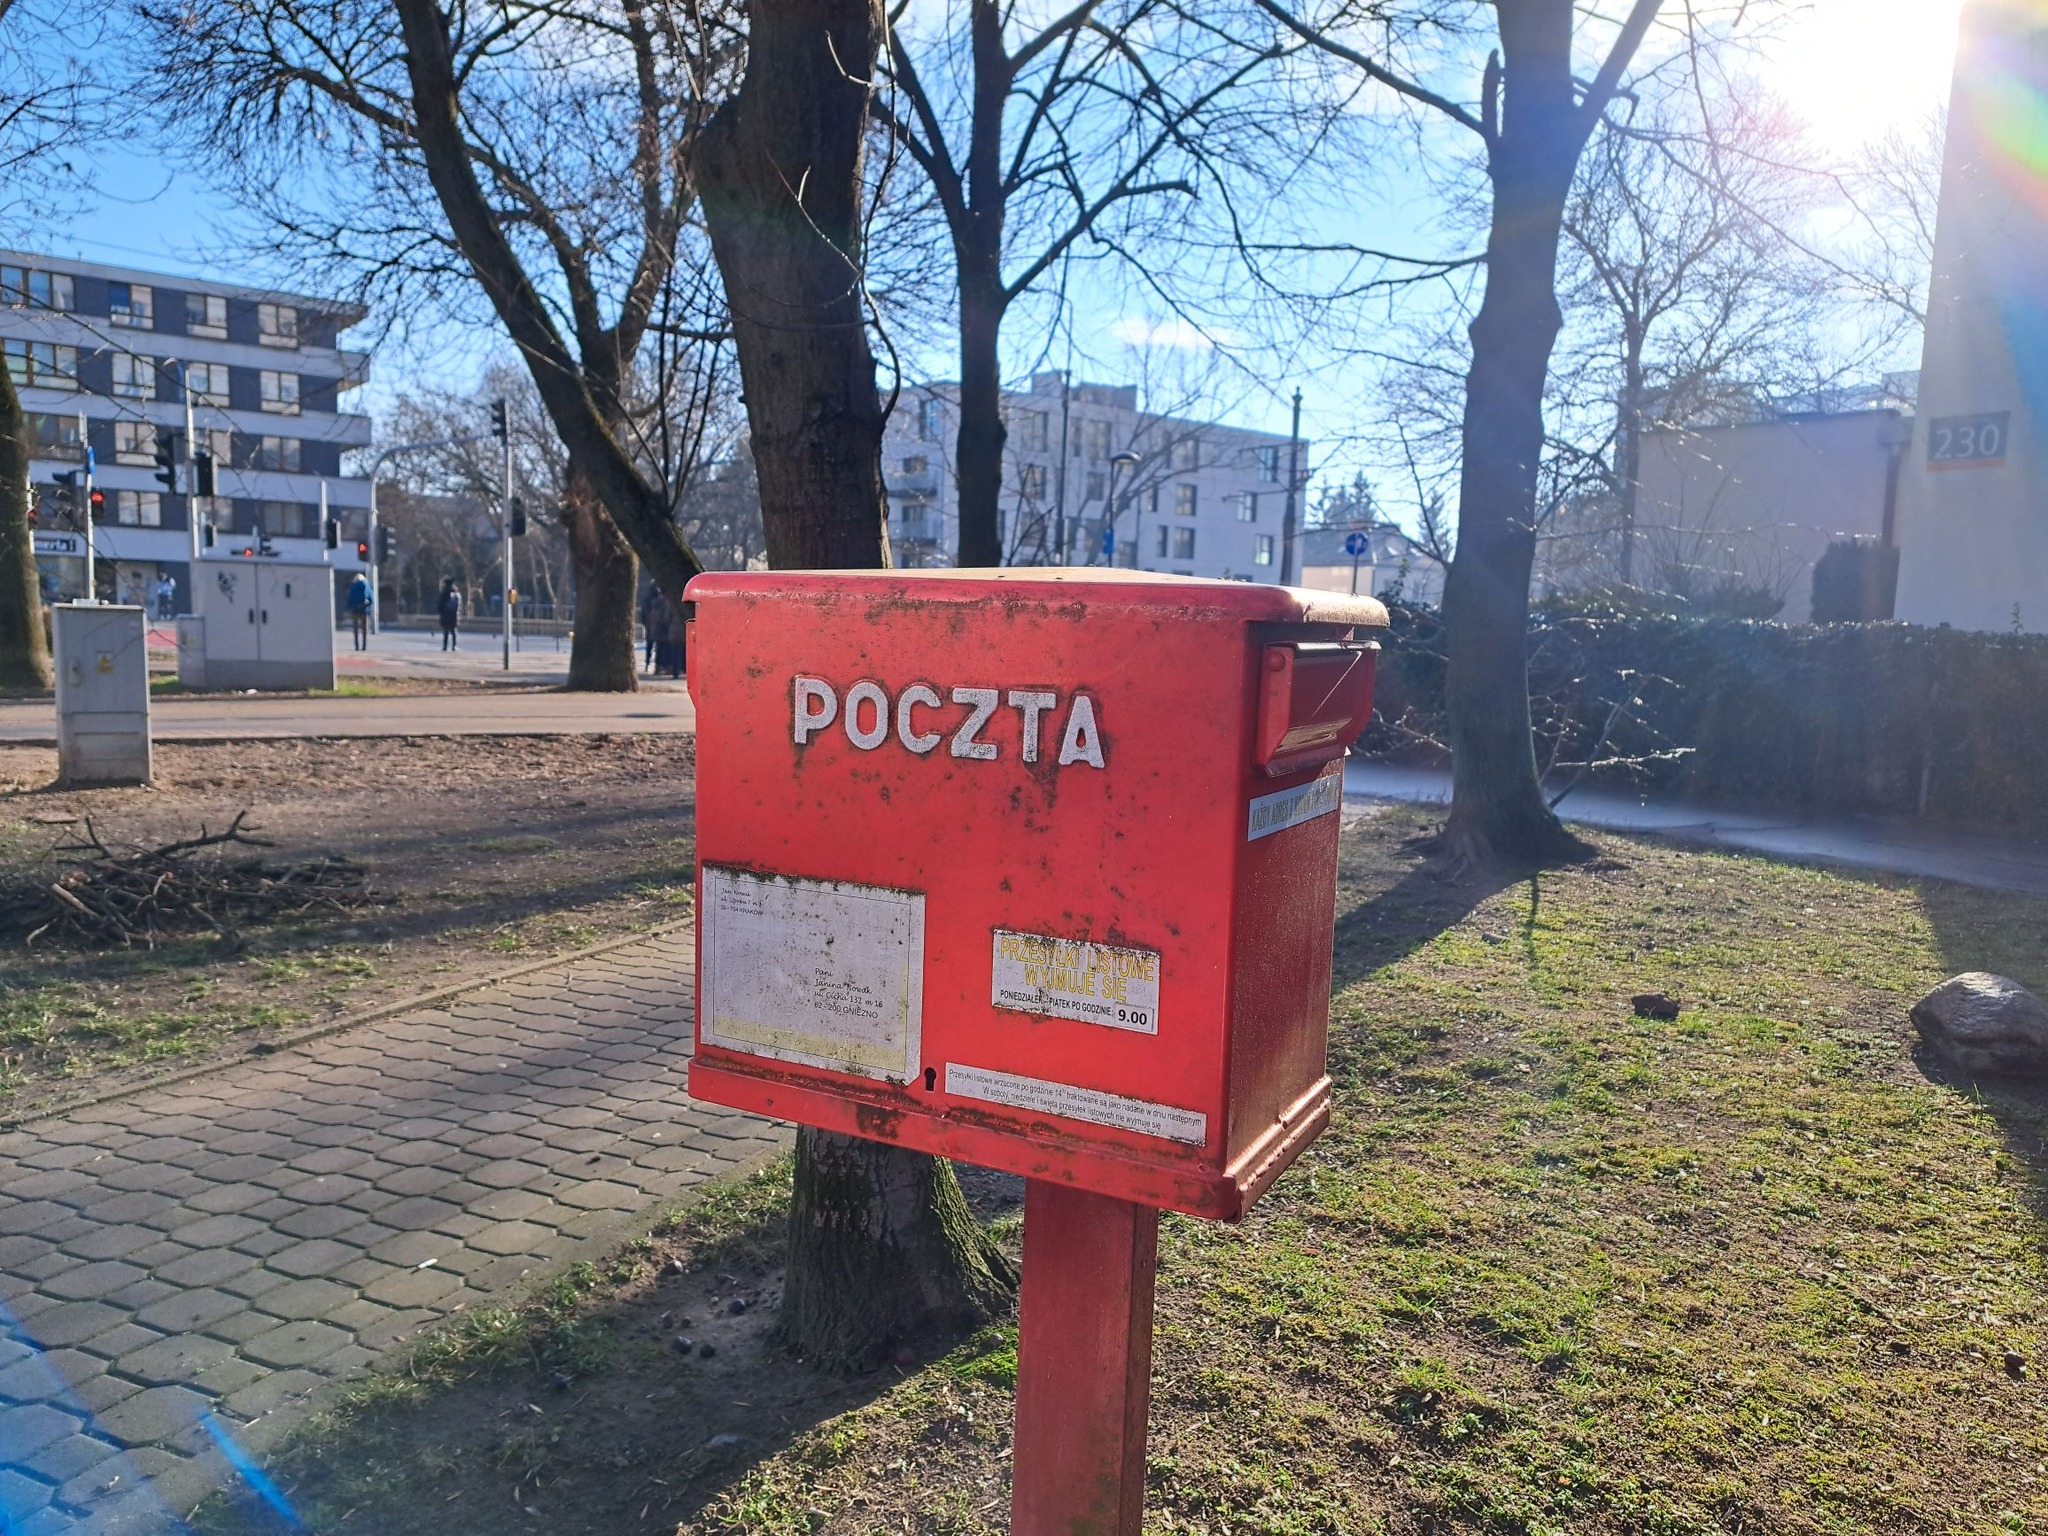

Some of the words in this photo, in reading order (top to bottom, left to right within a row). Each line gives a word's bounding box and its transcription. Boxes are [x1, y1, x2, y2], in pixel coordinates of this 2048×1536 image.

[1934, 424, 1999, 460] 230
[794, 675, 1105, 768] POCZTA
[815, 967, 834, 977] Pani
[1001, 937, 1080, 969] PRZESYŁKI
[1088, 949, 1154, 982] LISTOWE
[814, 979, 844, 990] Janina
[1025, 964, 1096, 996] WYJMUJE
[1102, 975, 1127, 1003] SIĘ
[826, 991, 848, 1001] Cicha
[850, 995, 862, 1005] 132
[875, 1000, 883, 1008] 16
[843, 1006, 878, 1019] GNIEZNO
[1049, 997, 1070, 1010] PIĄTEK
[1072, 1001, 1080, 1011] PO
[1118, 1009, 1147, 1025] 9.00
[949, 1069, 973, 1082] Przesyłki
[973, 1073, 993, 1085] listowe
[993, 1077, 1020, 1089] wrzucone
[1021, 1083, 1029, 1092] po
[1030, 1084, 1053, 1096] godzinie
[1067, 1091, 1099, 1105] traktowane
[1100, 1099, 1107, 1108] są
[1108, 1099, 1121, 1110] jako
[1122, 1103, 1145, 1115] nadane
[1153, 1108, 1167, 1119] dniu
[1168, 1112, 1202, 1127] następnym
[982, 1086, 990, 1095] W
[1011, 1092, 1036, 1104] niedziele
[1040, 1097, 1058, 1109] święta
[1058, 1100, 1086, 1115] przesyłek
[1087, 1107, 1114, 1120] listowych
[1115, 1113, 1125, 1122] nie
[1126, 1115, 1151, 1129] wyjmuje
[1151, 1120, 1161, 1130] się
